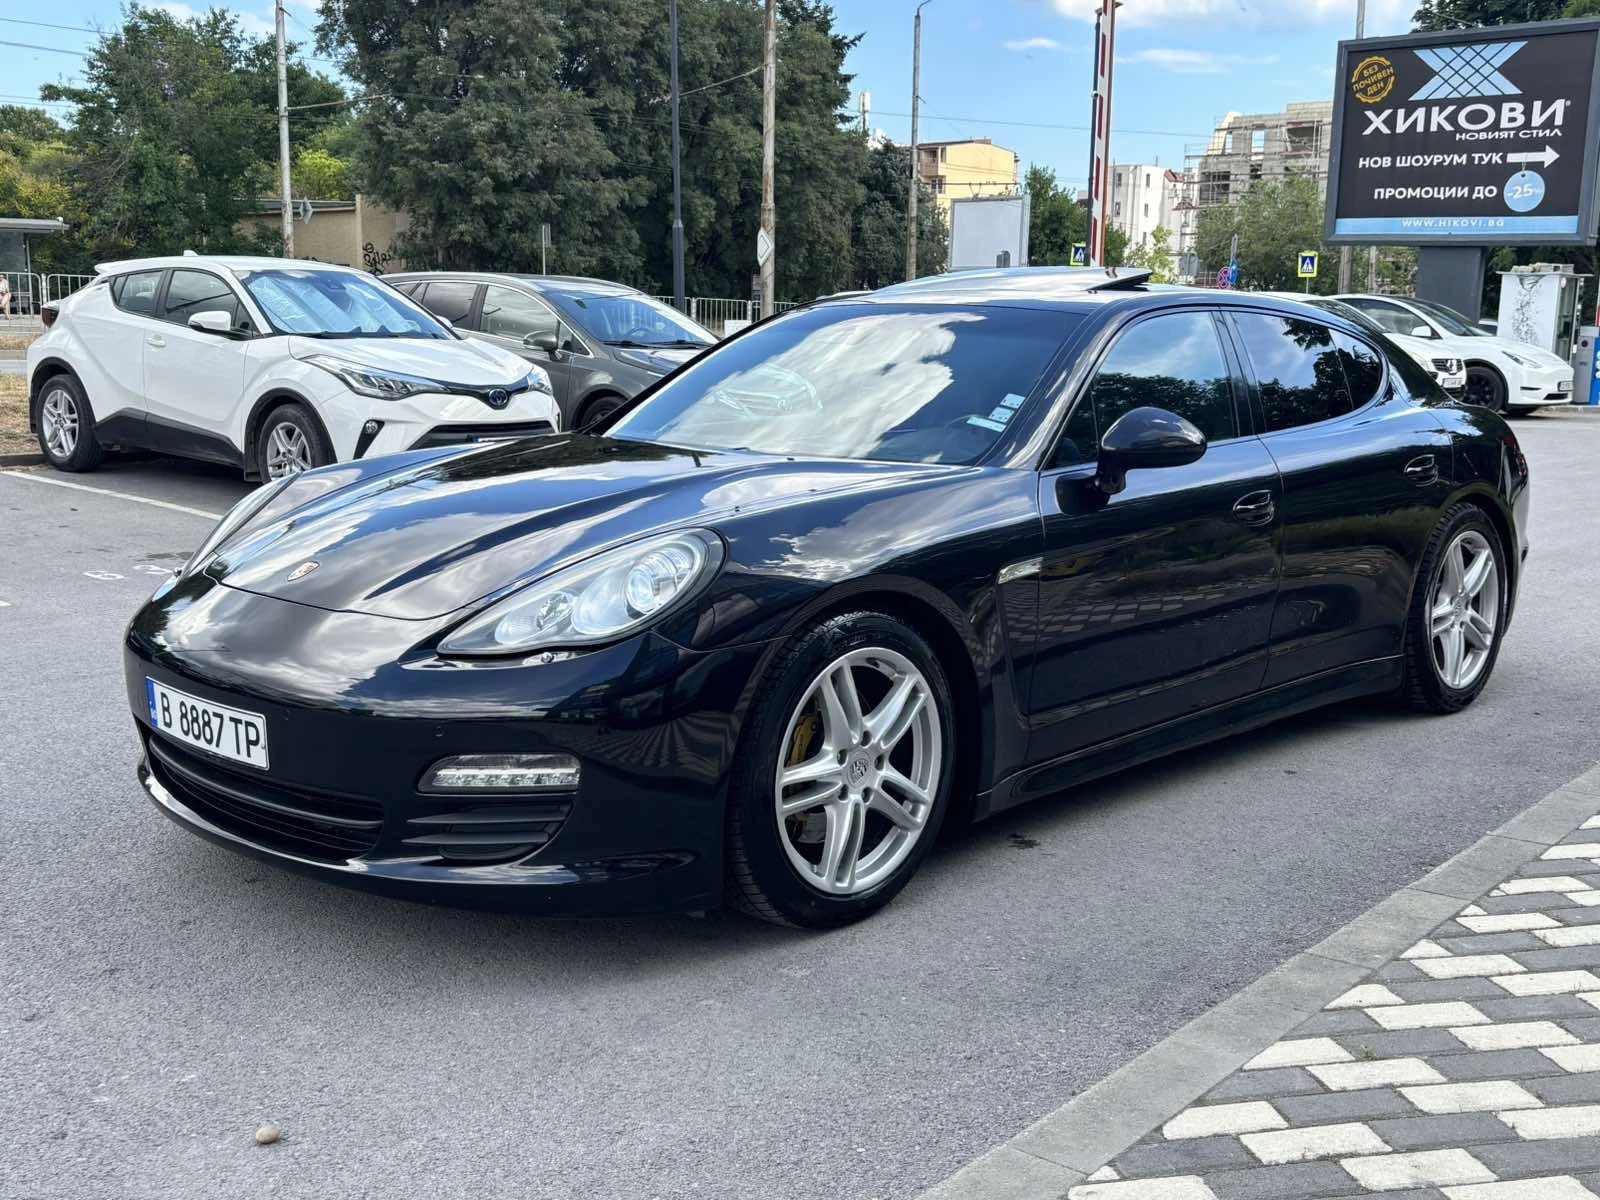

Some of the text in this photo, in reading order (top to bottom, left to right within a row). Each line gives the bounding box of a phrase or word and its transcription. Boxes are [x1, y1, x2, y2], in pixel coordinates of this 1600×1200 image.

[1363, 65, 1378, 77] БЕЗ
[1353, 66, 1394, 92] ПОЧИВЕН
[1367, 81, 1384, 96] ДЕН
[1362, 99, 1566, 135] ХИКОВИ
[1455, 129, 1563, 141] НОВИЯТ СТИЛ
[1358, 152, 1503, 168] НОВ ШОУРУМ ТУК
[1373, 187, 1469, 200] ПРОМОЦИИ
[1472, 186, 1498, 200] ДО
[1402, 217, 1505, 227] WWW.HIKOVI.BG
[160, 691, 172, 729] B
[179, 700, 224, 748] 8887
[229, 716, 260, 758] TP
